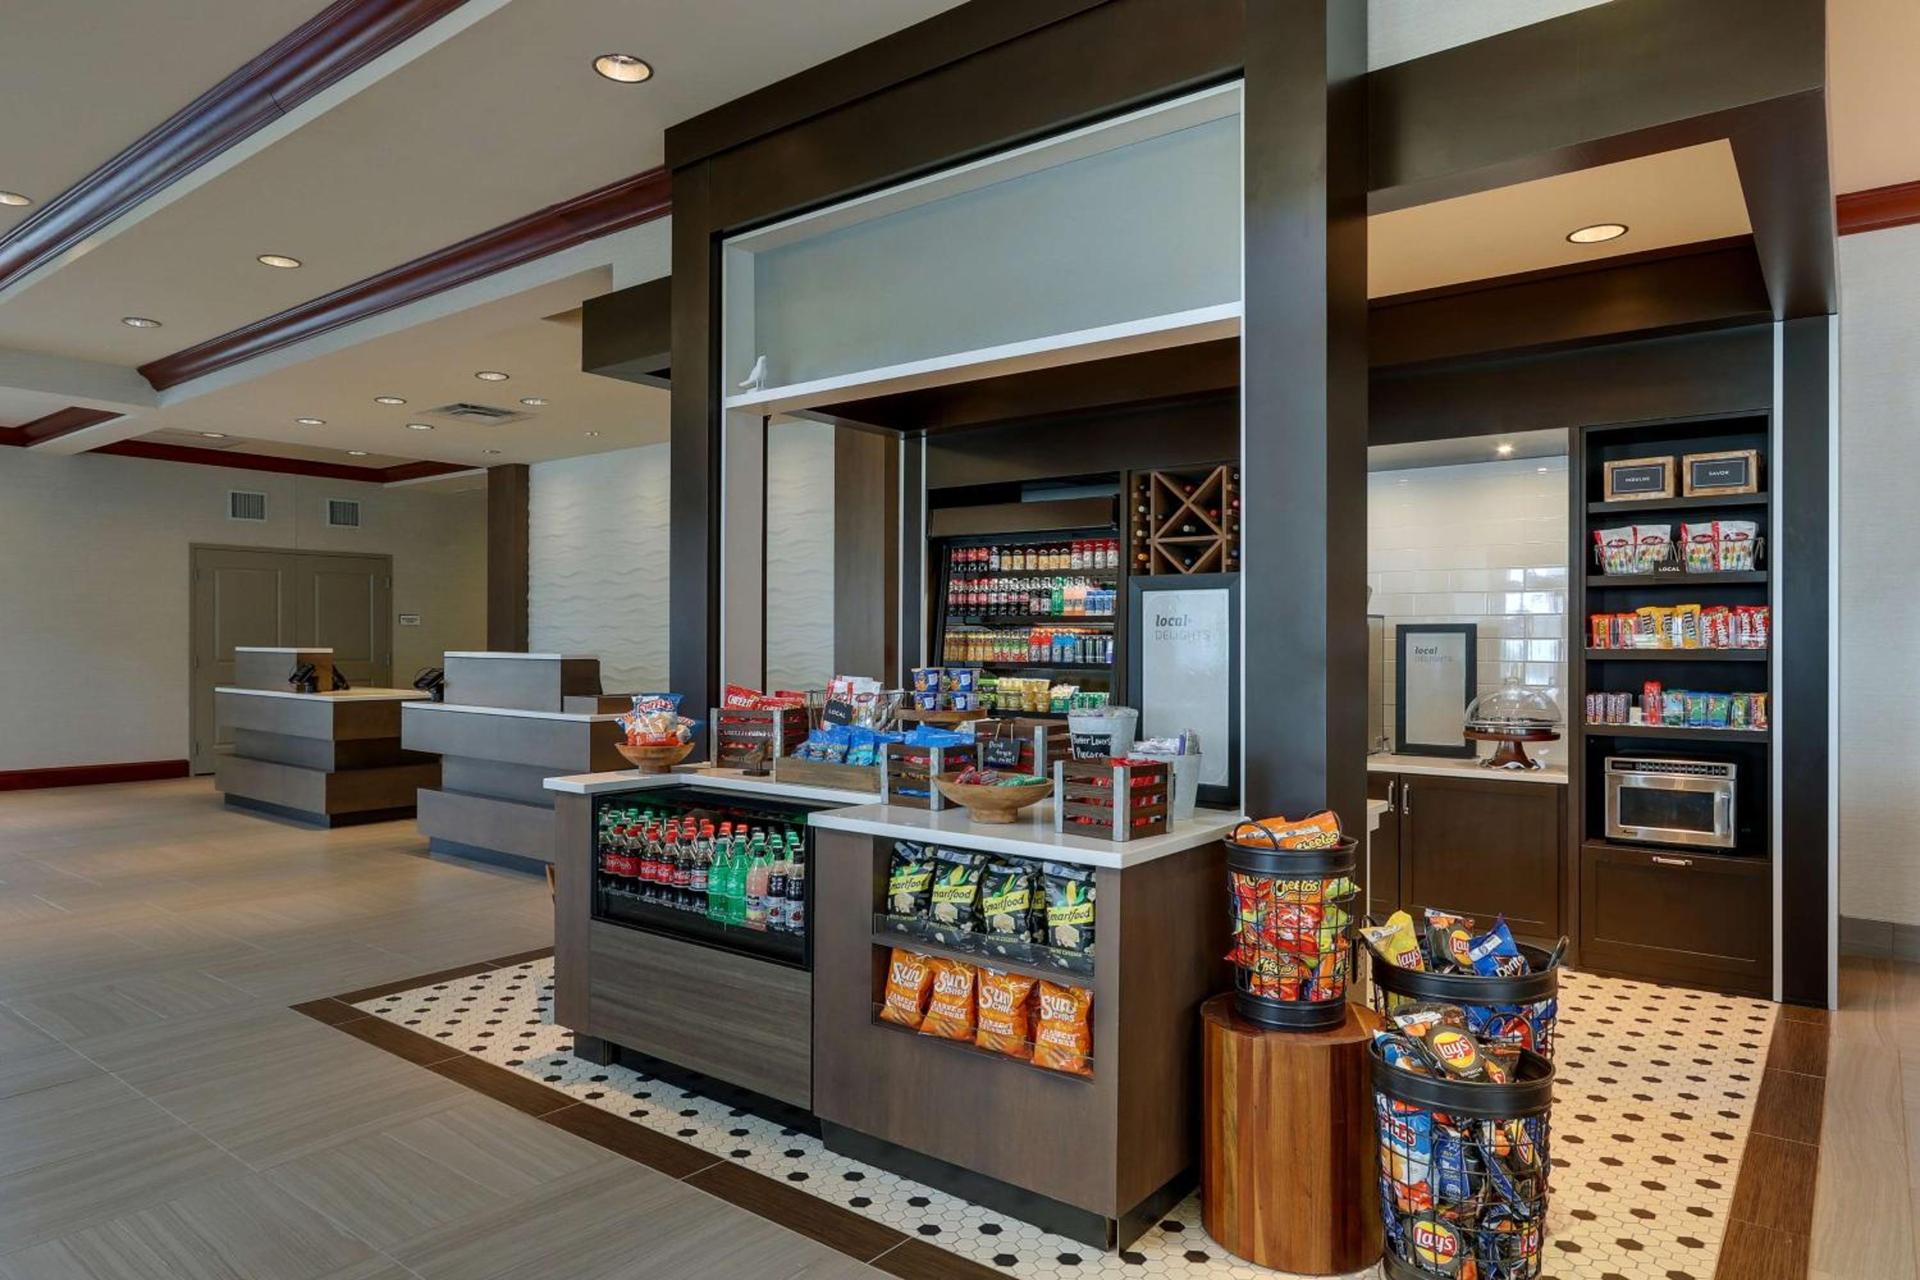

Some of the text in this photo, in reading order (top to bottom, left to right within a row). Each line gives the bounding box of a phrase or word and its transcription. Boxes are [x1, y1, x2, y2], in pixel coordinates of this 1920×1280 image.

[1155, 614, 1188, 627] local
[1415, 646, 1438, 655] local
[829, 708, 846, 718] LOCAL
[933, 889, 971, 900] martfood
[1276, 880, 1319, 897] Cheetos
[984, 894, 1025, 913] Smartfood
[891, 962, 921, 985] Sun
[934, 970, 968, 993] Sun
[980, 986, 1012, 1009] Sun
[1040, 995, 1076, 1020] Sun
[1438, 1039, 1470, 1060] Lay's
[1415, 1228, 1454, 1253] Lay's
